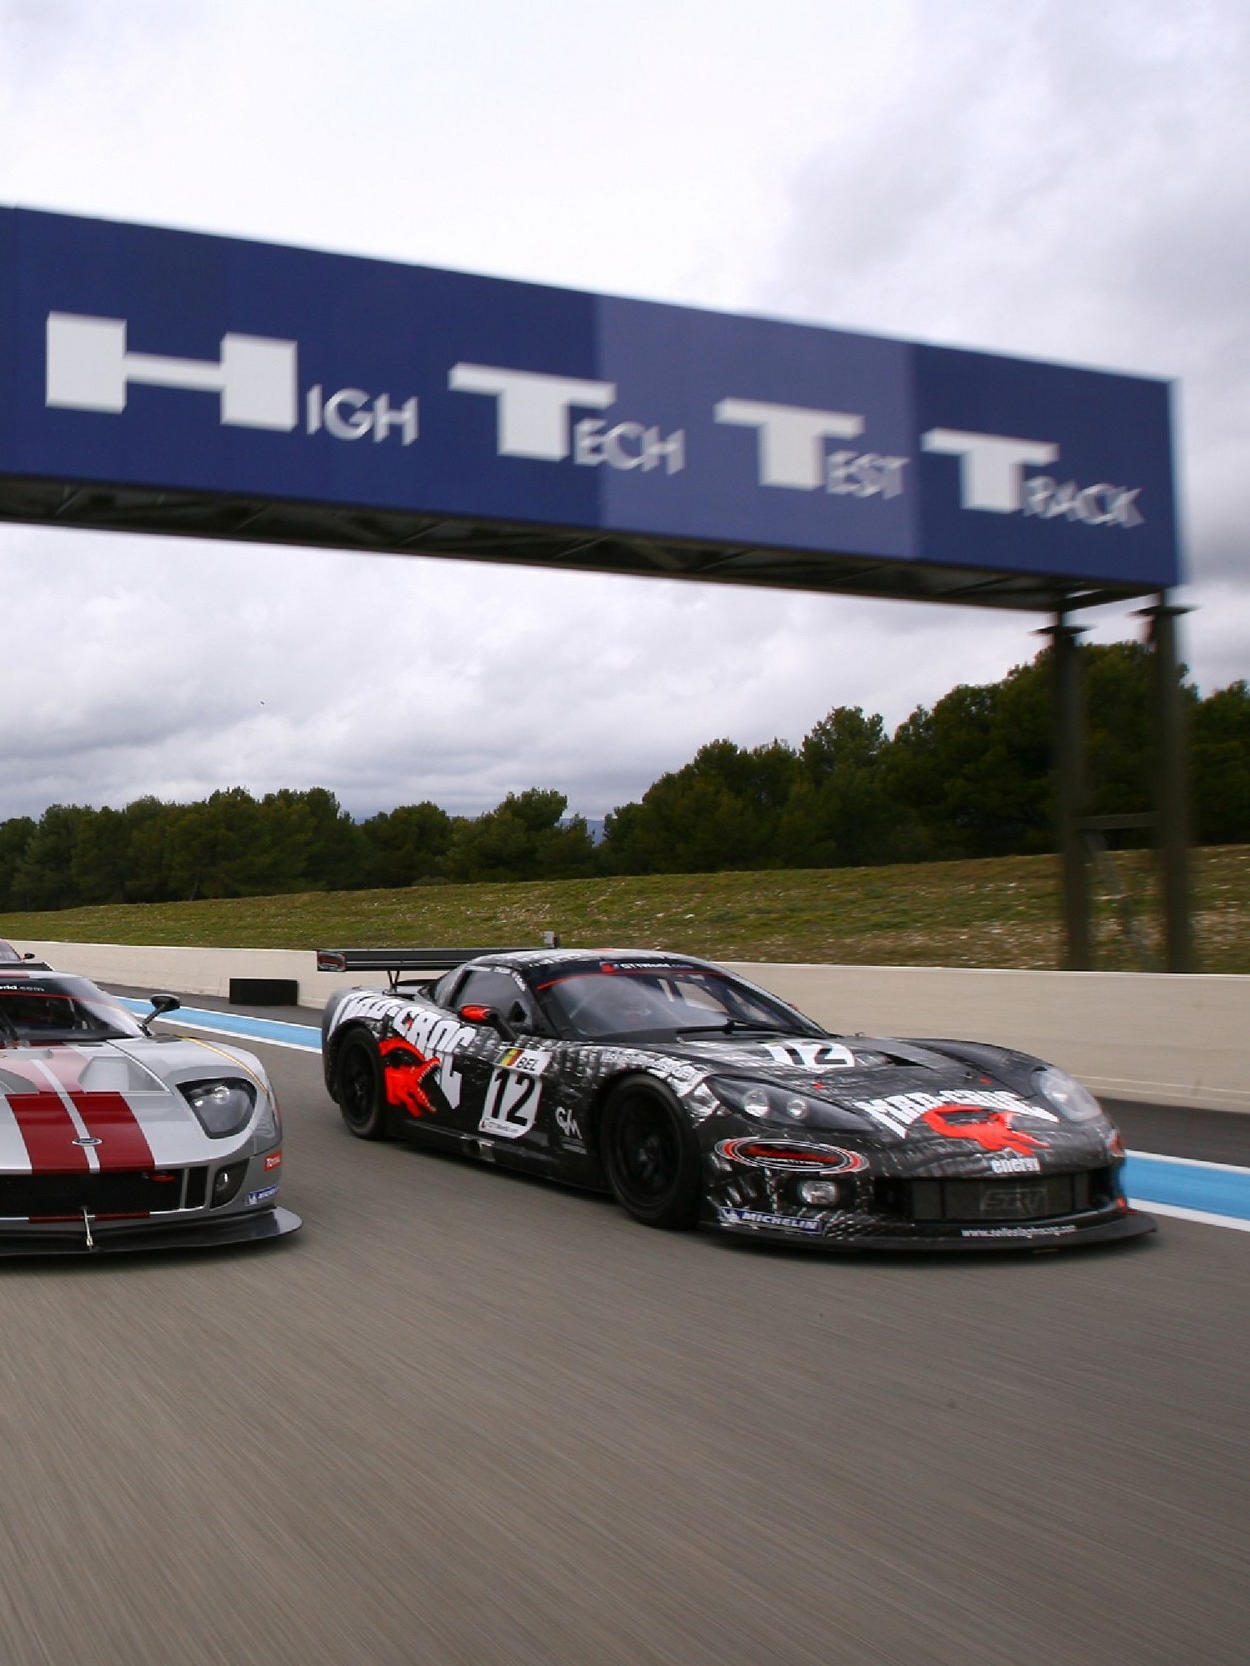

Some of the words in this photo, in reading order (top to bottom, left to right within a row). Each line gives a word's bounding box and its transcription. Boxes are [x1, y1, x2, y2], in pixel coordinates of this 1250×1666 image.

[45, 310, 419, 447] HIGH
[449, 362, 685, 475] TECH
[715, 396, 910, 500] TEST
[922, 427, 1145, 528] TRACK
[517, 1057, 538, 1072] BEL
[491, 1068, 536, 1127] 12
[741, 1211, 819, 1230] MICHELIN
